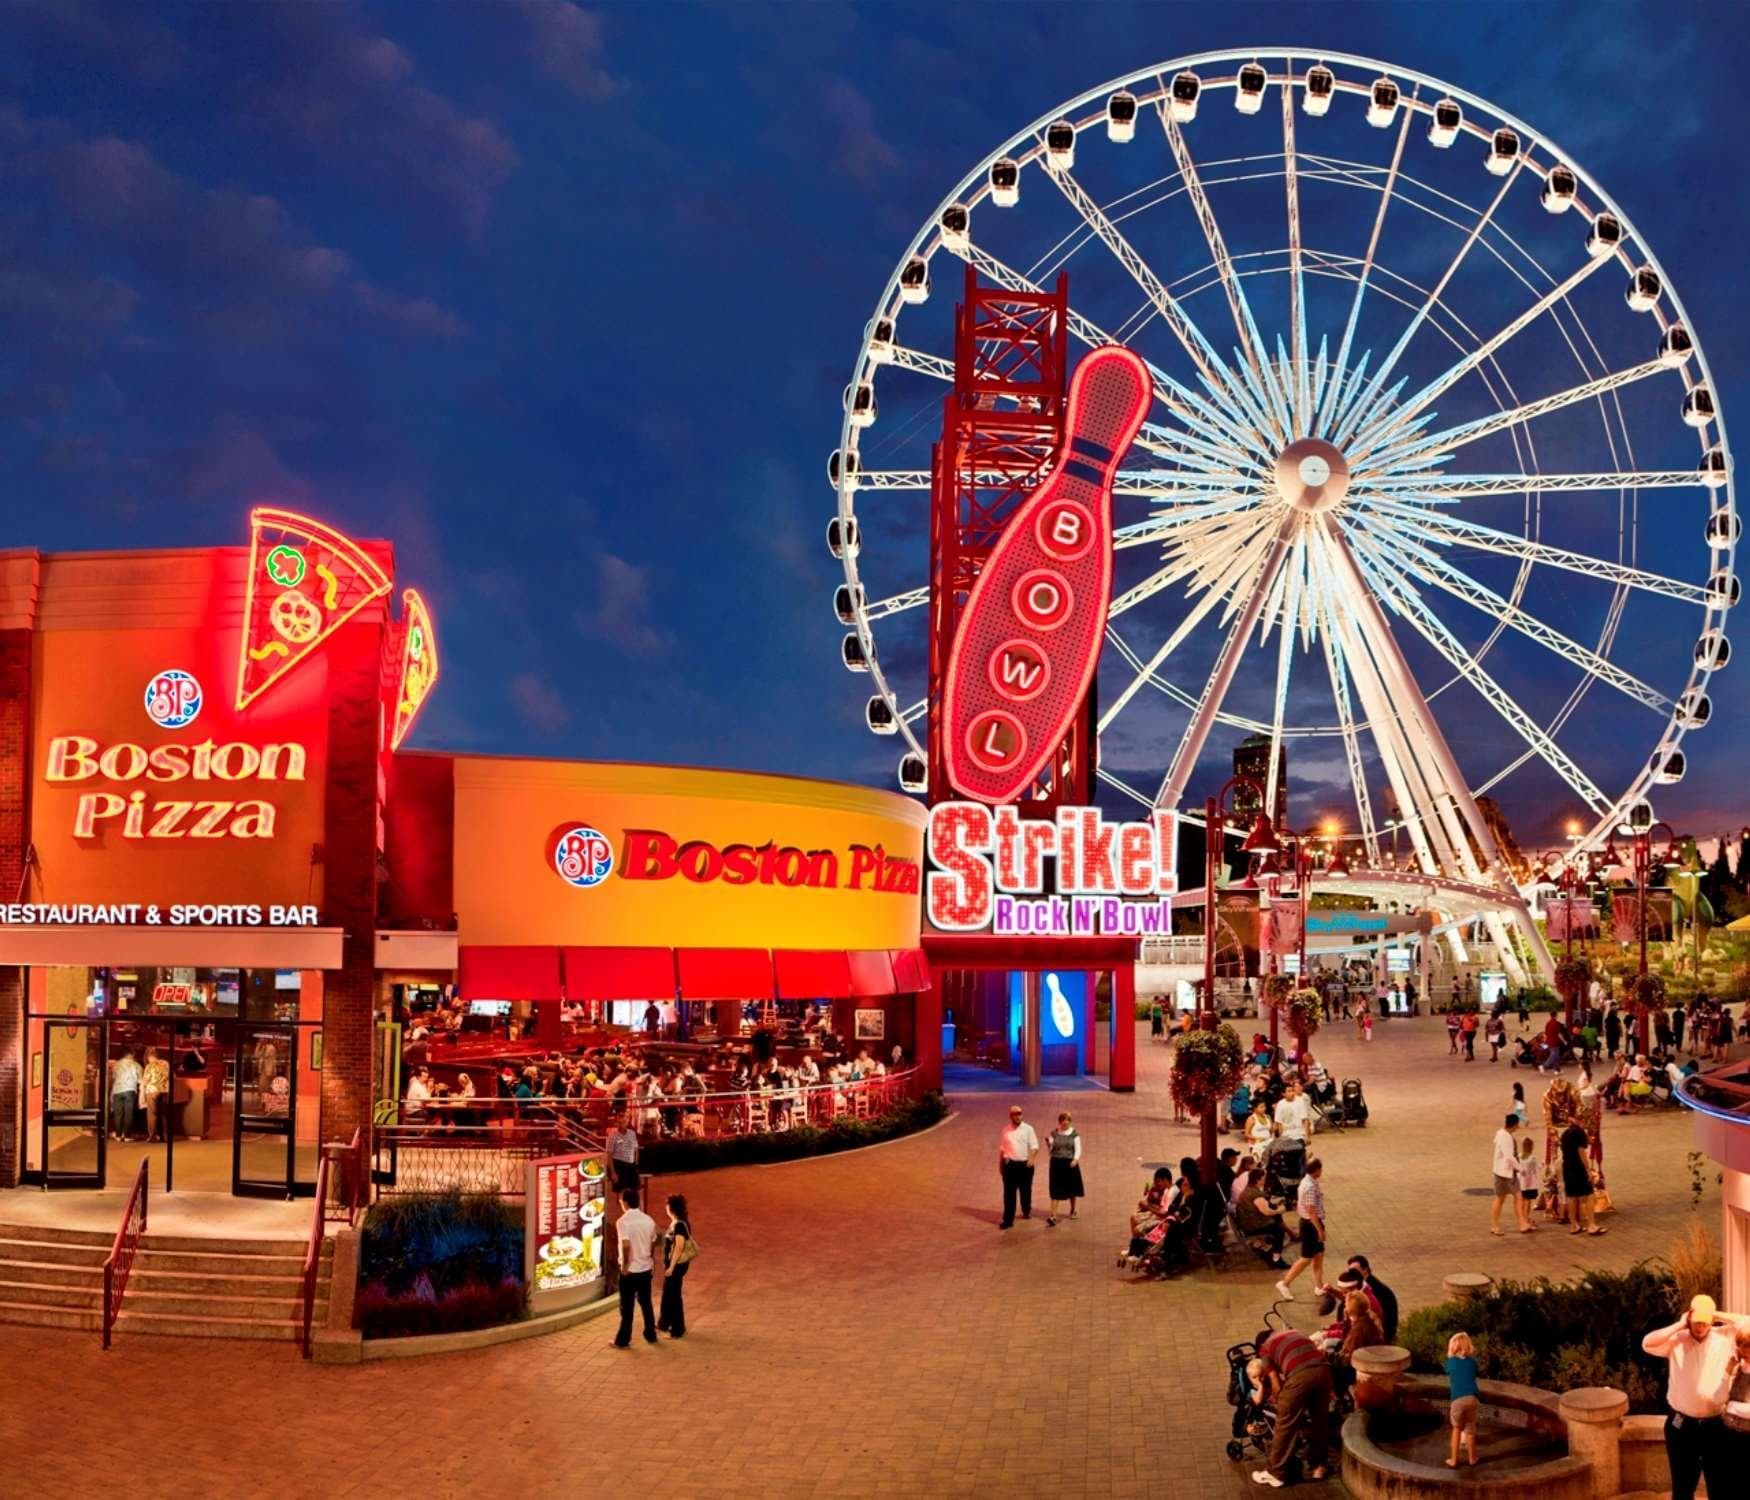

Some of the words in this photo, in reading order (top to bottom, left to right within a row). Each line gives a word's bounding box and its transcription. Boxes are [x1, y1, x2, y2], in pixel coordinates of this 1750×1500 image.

[980, 509, 1081, 758] BOWL
[44, 736, 306, 782] Boston
[73, 790, 276, 838] Pizza
[620, 829, 838, 888] Boston
[847, 844, 919, 895] Pizza
[927, 801, 1178, 930] Strike!
[145, 904, 162, 924] &
[169, 904, 262, 925] SPORTS
[269, 904, 318, 925] BAR
[994, 896, 1070, 935] Rock
[1102, 897, 1171, 935] Bowl
[153, 985, 192, 1001] OPEN
